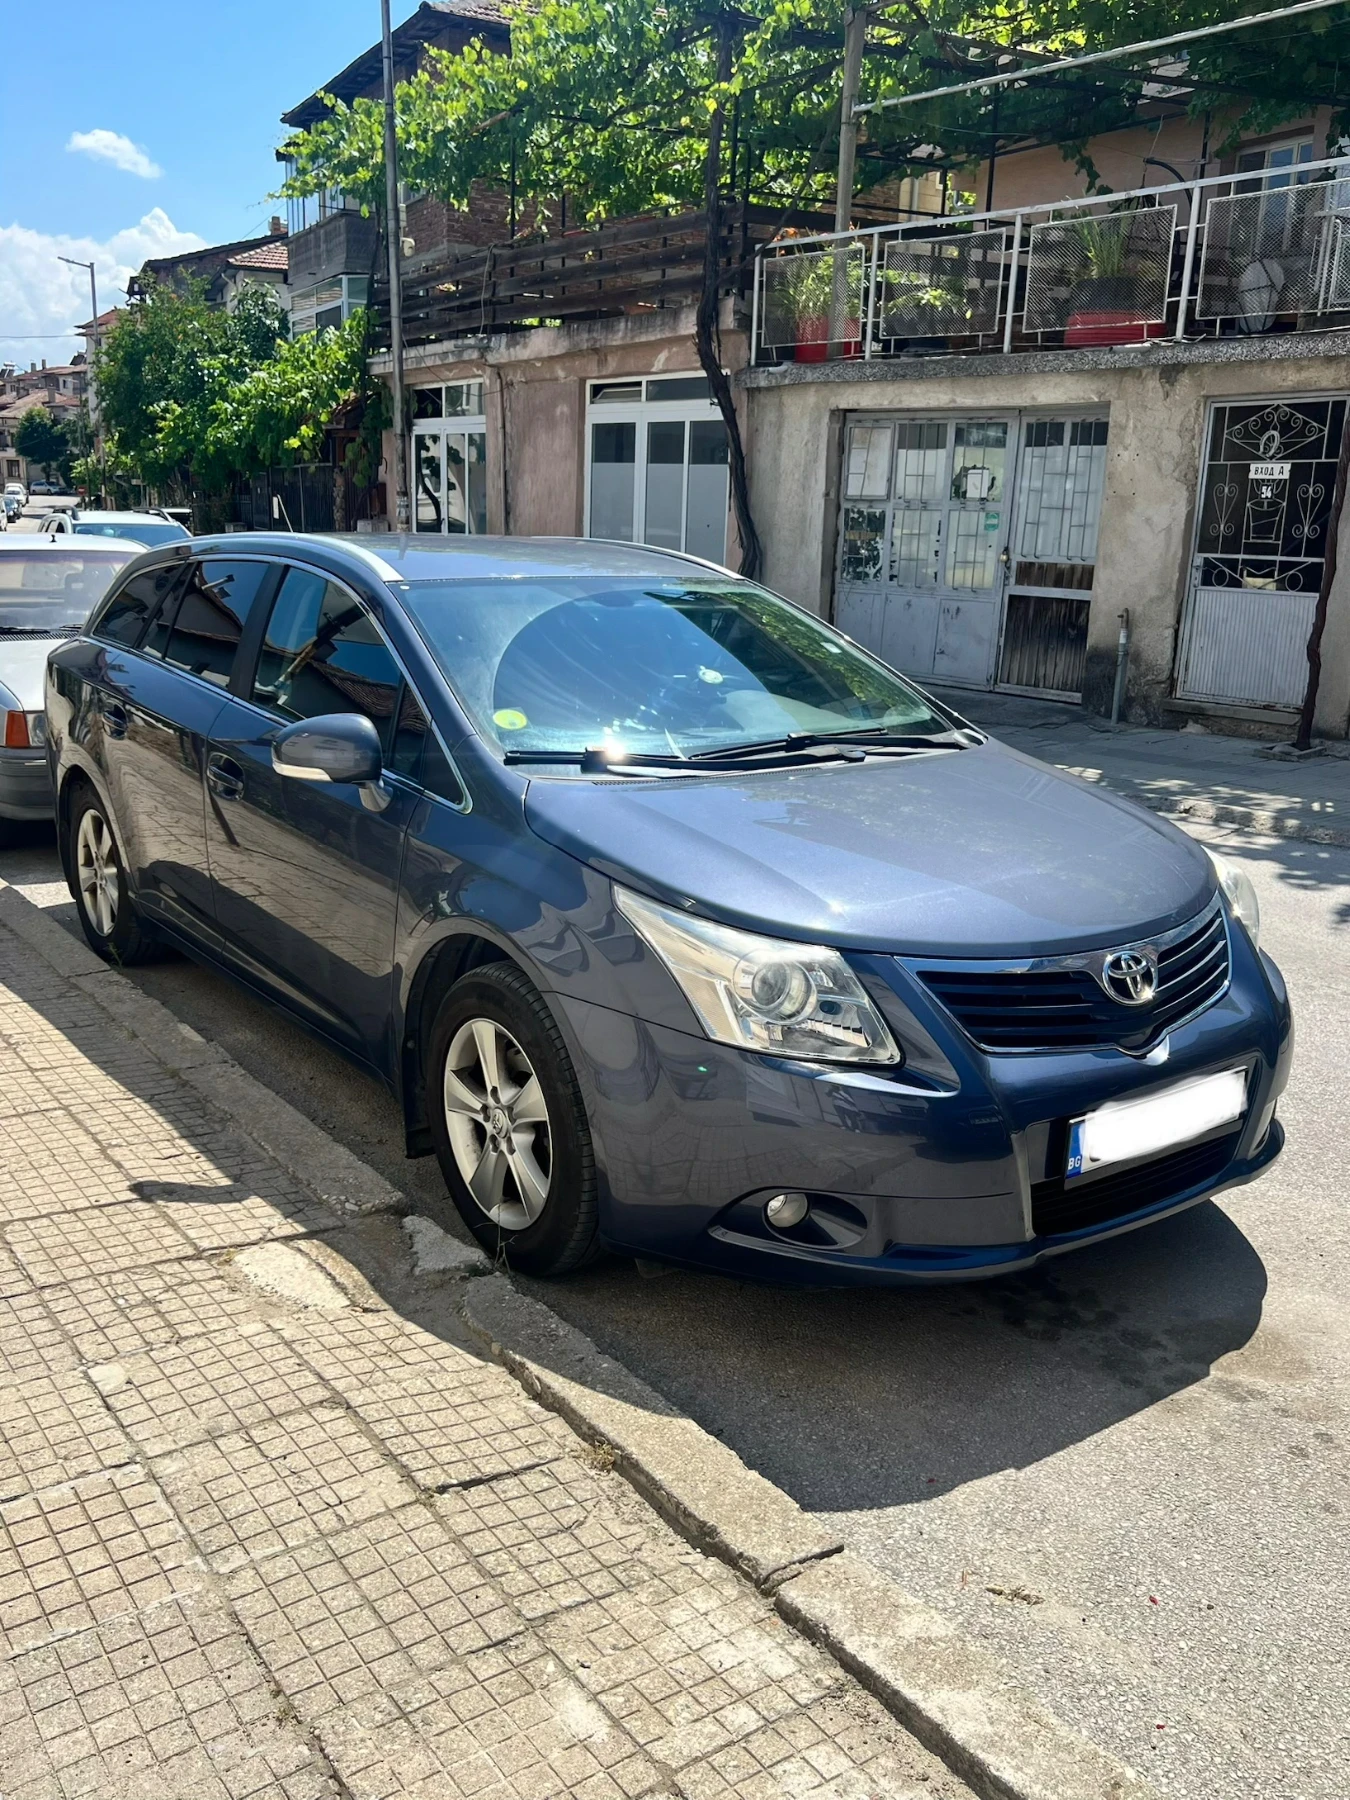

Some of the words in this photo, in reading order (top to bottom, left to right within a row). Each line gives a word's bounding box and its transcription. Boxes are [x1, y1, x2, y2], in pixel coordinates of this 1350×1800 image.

[1254, 466, 1274, 476] ВХОД
[1278, 465, 1284, 476] А
[1068, 1155, 1082, 1170] BG
